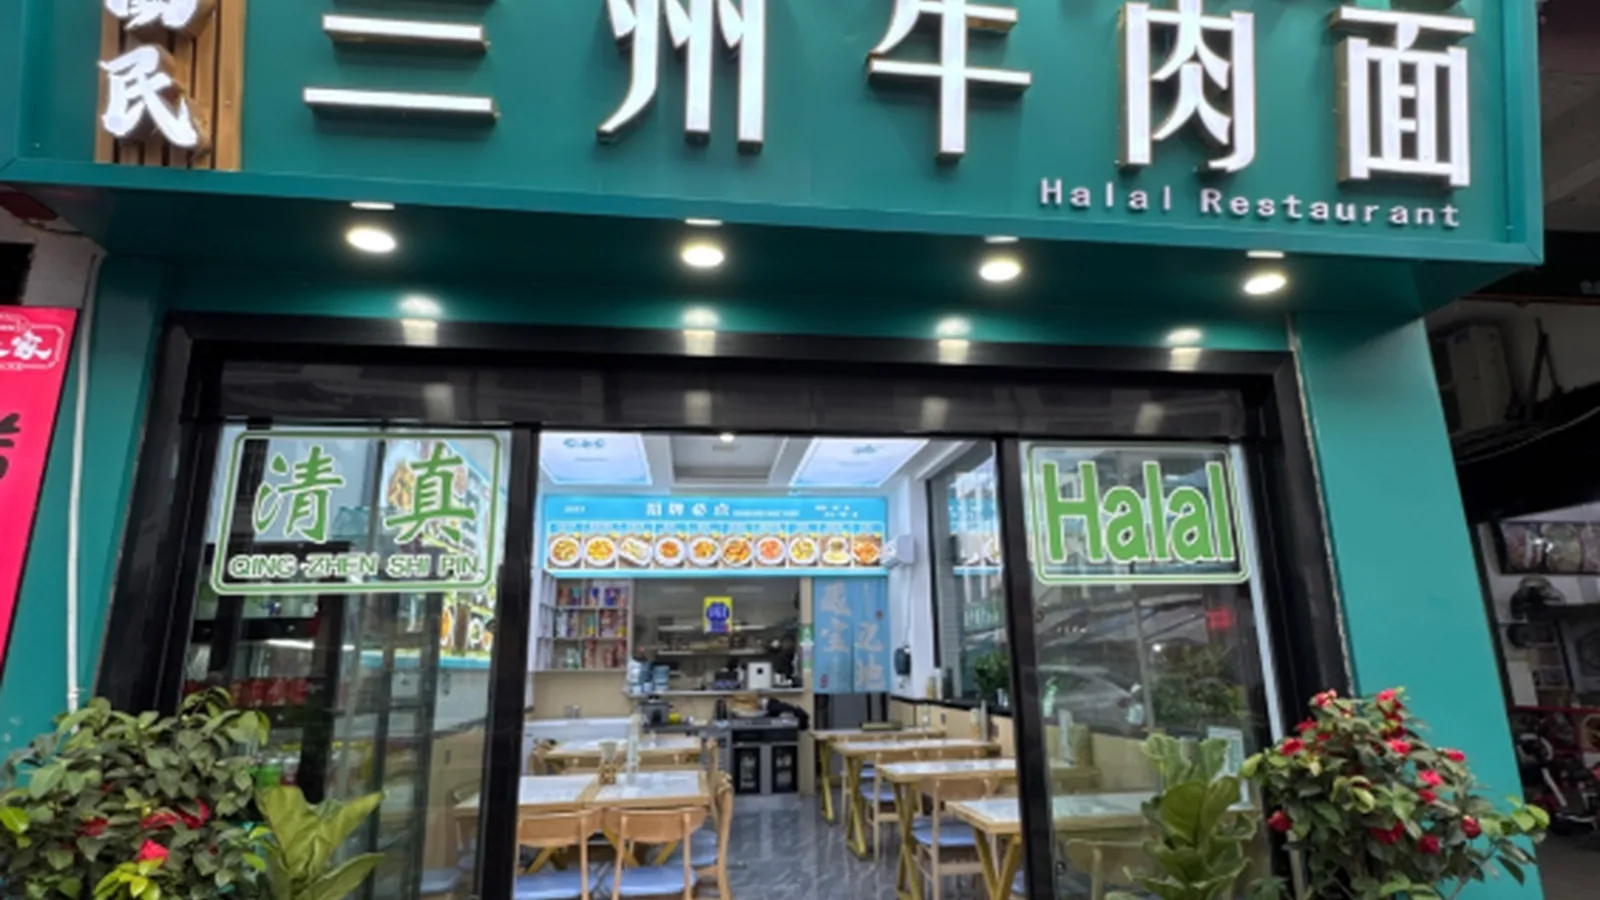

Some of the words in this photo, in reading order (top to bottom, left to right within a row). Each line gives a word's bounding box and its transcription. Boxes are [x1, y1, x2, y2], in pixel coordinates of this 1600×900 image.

[97, 0, 199, 147] 民
[1040, 177, 1172, 212] Halal
[1200, 188, 1461, 228] Restaurant
[253, 441, 477, 544] 清真
[1040, 461, 1236, 564] Halal
[228, 555, 298, 579] QING
[303, 553, 379, 578] ZHEN
[386, 554, 431, 577] SHI
[440, 555, 479, 577] PIN
